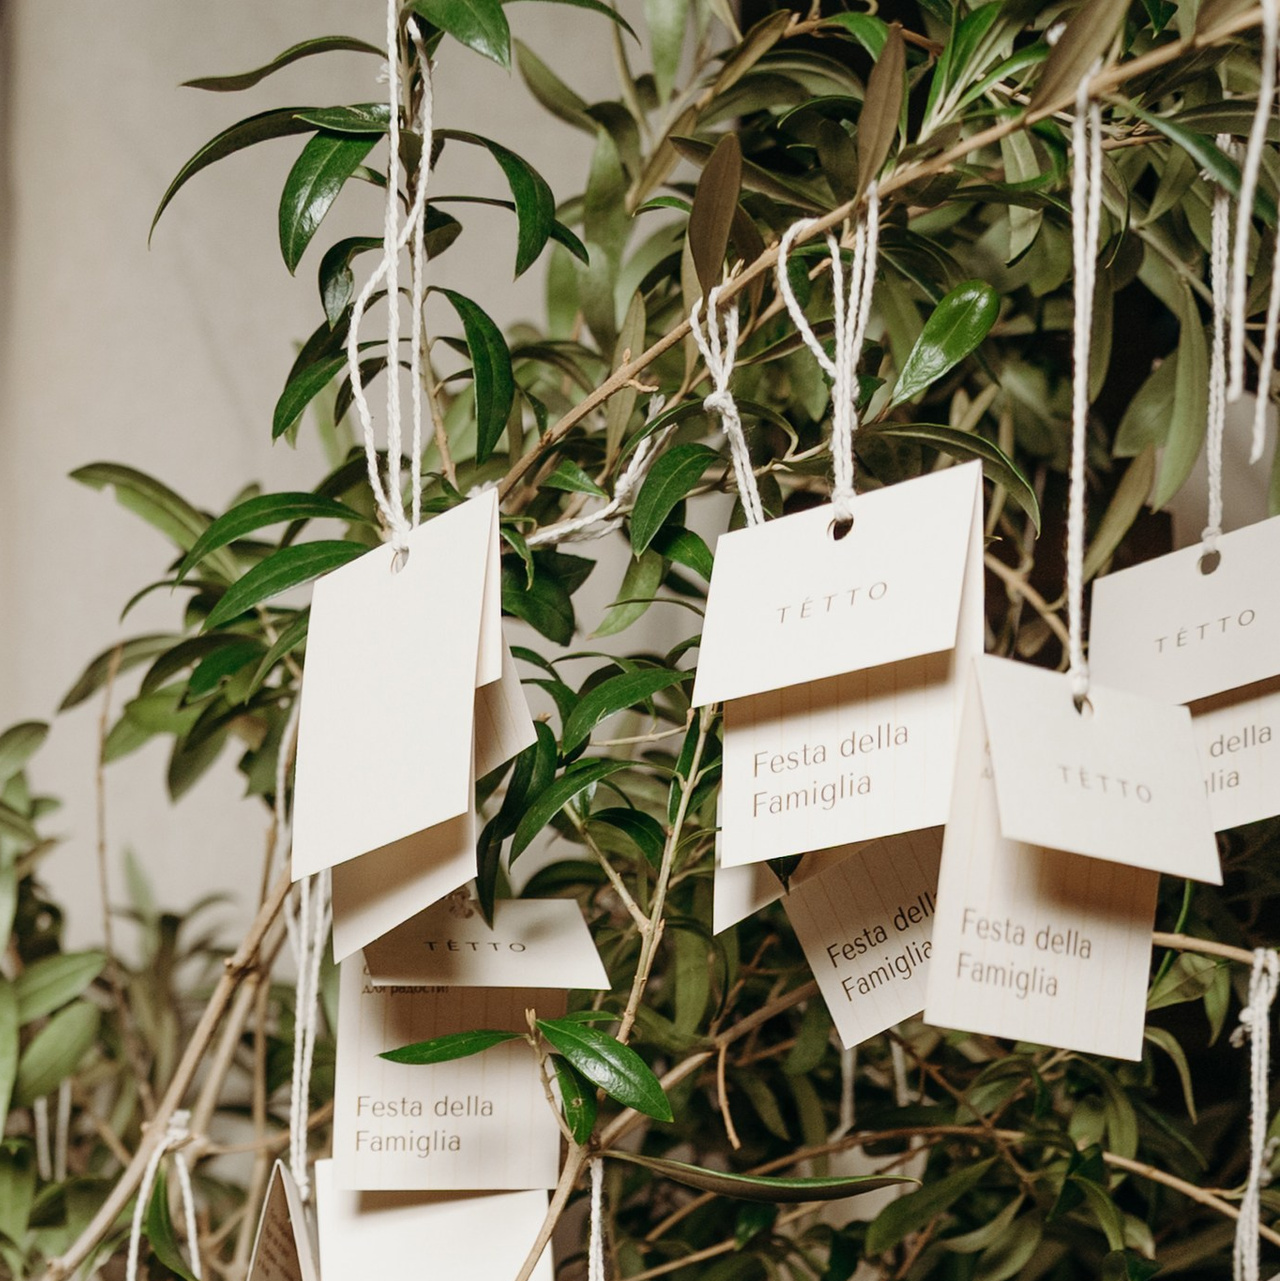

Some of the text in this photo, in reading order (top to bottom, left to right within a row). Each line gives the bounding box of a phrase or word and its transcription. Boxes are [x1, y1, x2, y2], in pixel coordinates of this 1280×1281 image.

[777, 581, 888, 624] TÉTTO
[1154, 609, 1256, 653] TÉTTO
[753, 722, 909, 778] Festa della
[1209, 724, 1272, 758] della
[752, 772, 872, 818] Famiglia
[424, 939, 526, 953] TÉTTO
[826, 891, 938, 969] Festa dell
[961, 907, 1093, 960] Festa della
[841, 939, 933, 1002] Famiglia
[956, 952, 1058, 1000] Famiglia
[357, 1096, 493, 1118] Festa della
[356, 1130, 461, 1158] Famiglia
